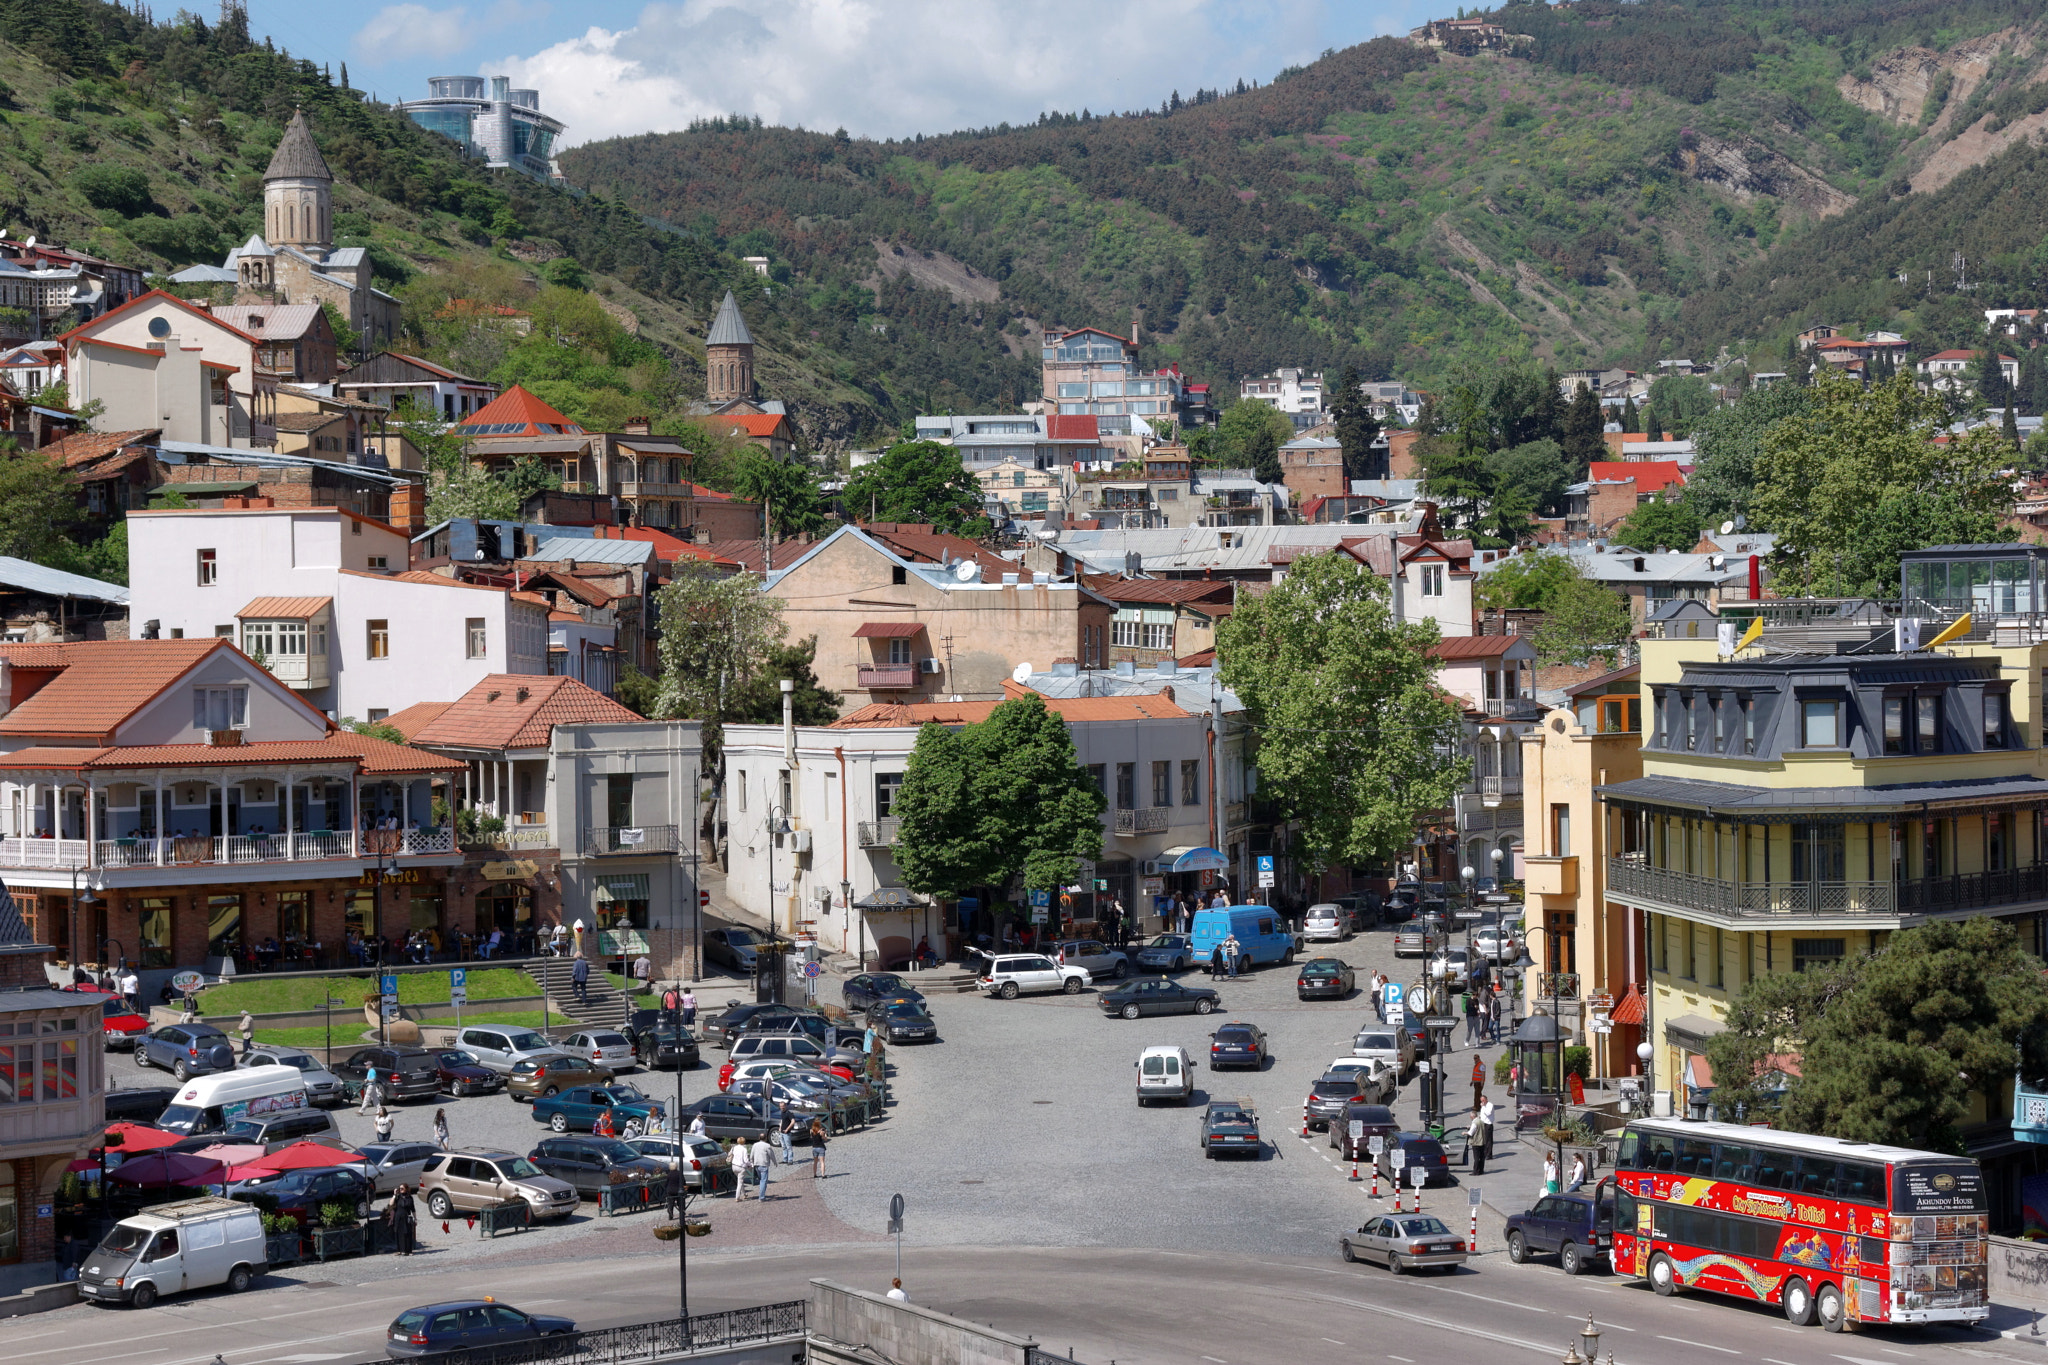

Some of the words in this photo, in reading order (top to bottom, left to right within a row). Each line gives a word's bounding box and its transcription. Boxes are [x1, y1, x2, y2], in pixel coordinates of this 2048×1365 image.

[1036, 891, 1047, 905] P
[453, 970, 463, 986] P
[1388, 985, 1399, 999] P
[1916, 1197, 1952, 1205] AKHUNDOV
[1953, 1197, 1973, 1205] HOUSE
[1797, 1203, 1826, 1224] Tbilisi
